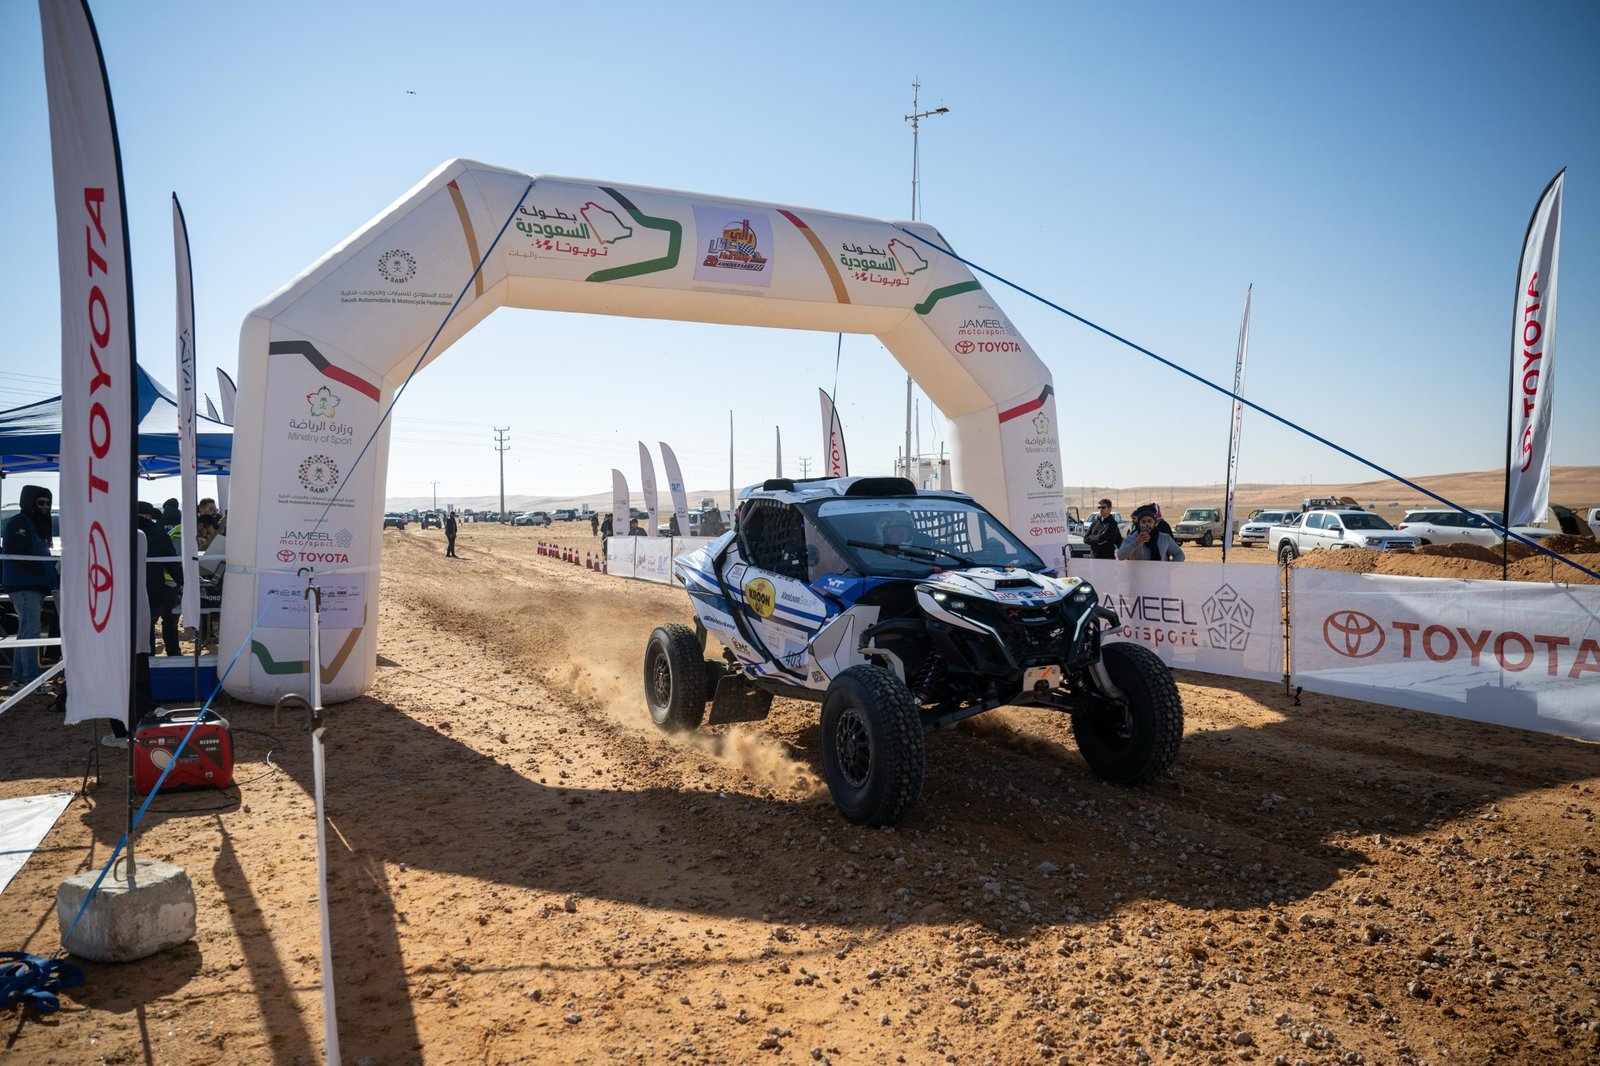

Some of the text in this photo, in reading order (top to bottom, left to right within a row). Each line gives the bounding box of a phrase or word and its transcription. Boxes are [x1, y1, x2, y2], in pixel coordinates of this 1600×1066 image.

[519, 205, 577, 223] بطولة
[516, 218, 590, 239] السعودية
[556, 241, 608, 257] تويوتا
[842, 243, 886, 258] بطولة
[840, 254, 896, 271] السعودية
[870, 273, 909, 286] تويوتا
[397, 298, 427, 306] Motorcycle
[959, 319, 1004, 328] JAMEEL
[958, 328, 1006, 336] motorsport
[84, 187, 111, 503] TOYOTA
[977, 341, 1022, 353] TOYOTA
[1522, 271, 1543, 419] TOYOTA
[289, 419, 353, 436] وزارة الرياضة
[288, 432, 352, 446] Ministry of Sport
[280, 530, 334, 541] JAMEEL
[298, 552, 349, 563] TOYOTA
[748, 588, 770, 606] KROON
[1102, 594, 1197, 625] AMEEL
[1104, 623, 1198, 647] orsport
[1391, 621, 1600, 679] TOYOTA
